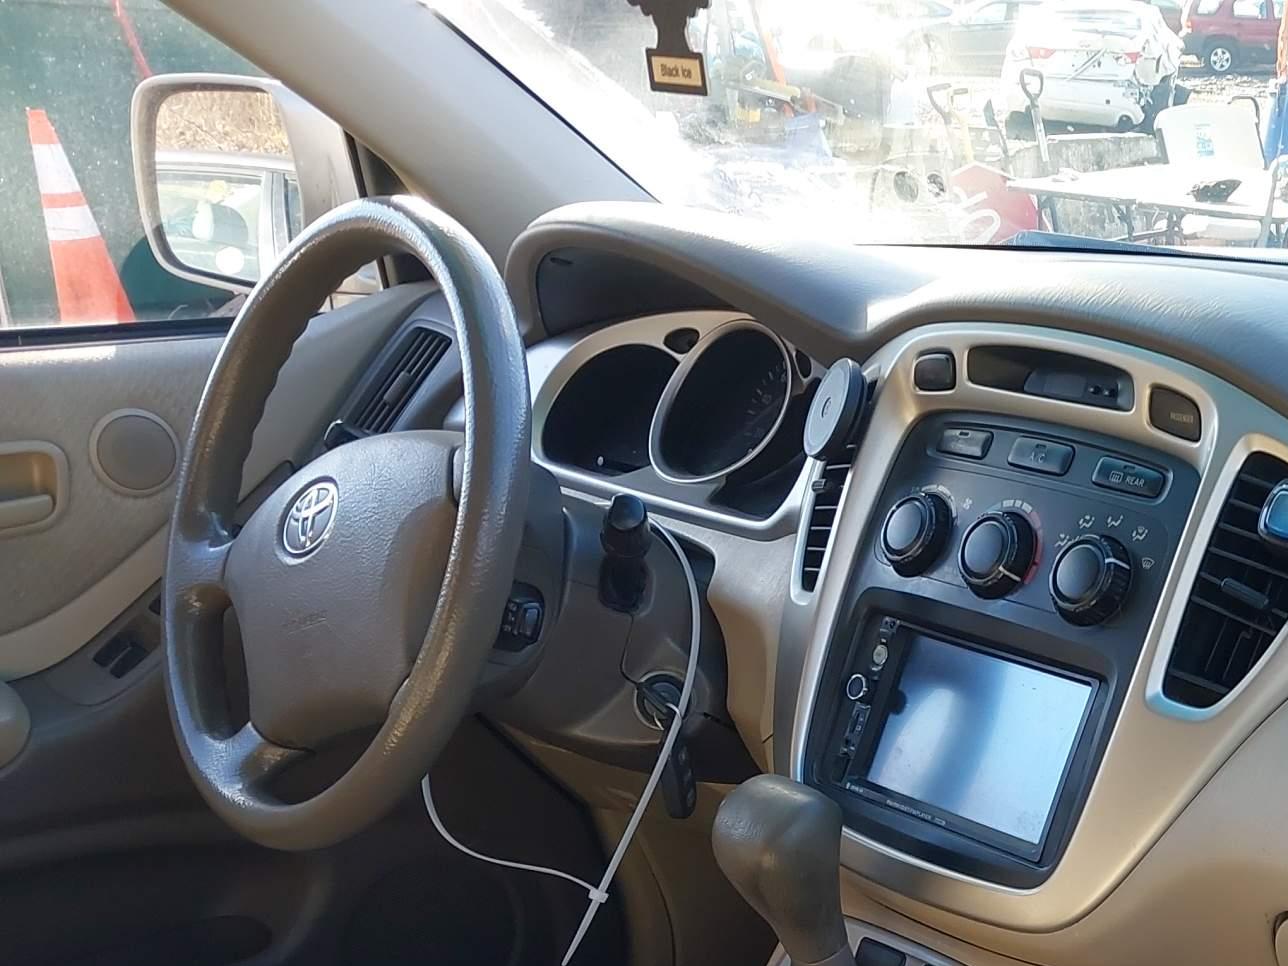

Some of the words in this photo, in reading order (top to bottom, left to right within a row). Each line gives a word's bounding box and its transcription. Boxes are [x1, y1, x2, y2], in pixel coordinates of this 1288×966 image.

[660, 63, 680, 78] Black
[681, 65, 692, 79] Ice
[1028, 451, 1046, 463] A/C
[1125, 475, 1145, 488] REAR
